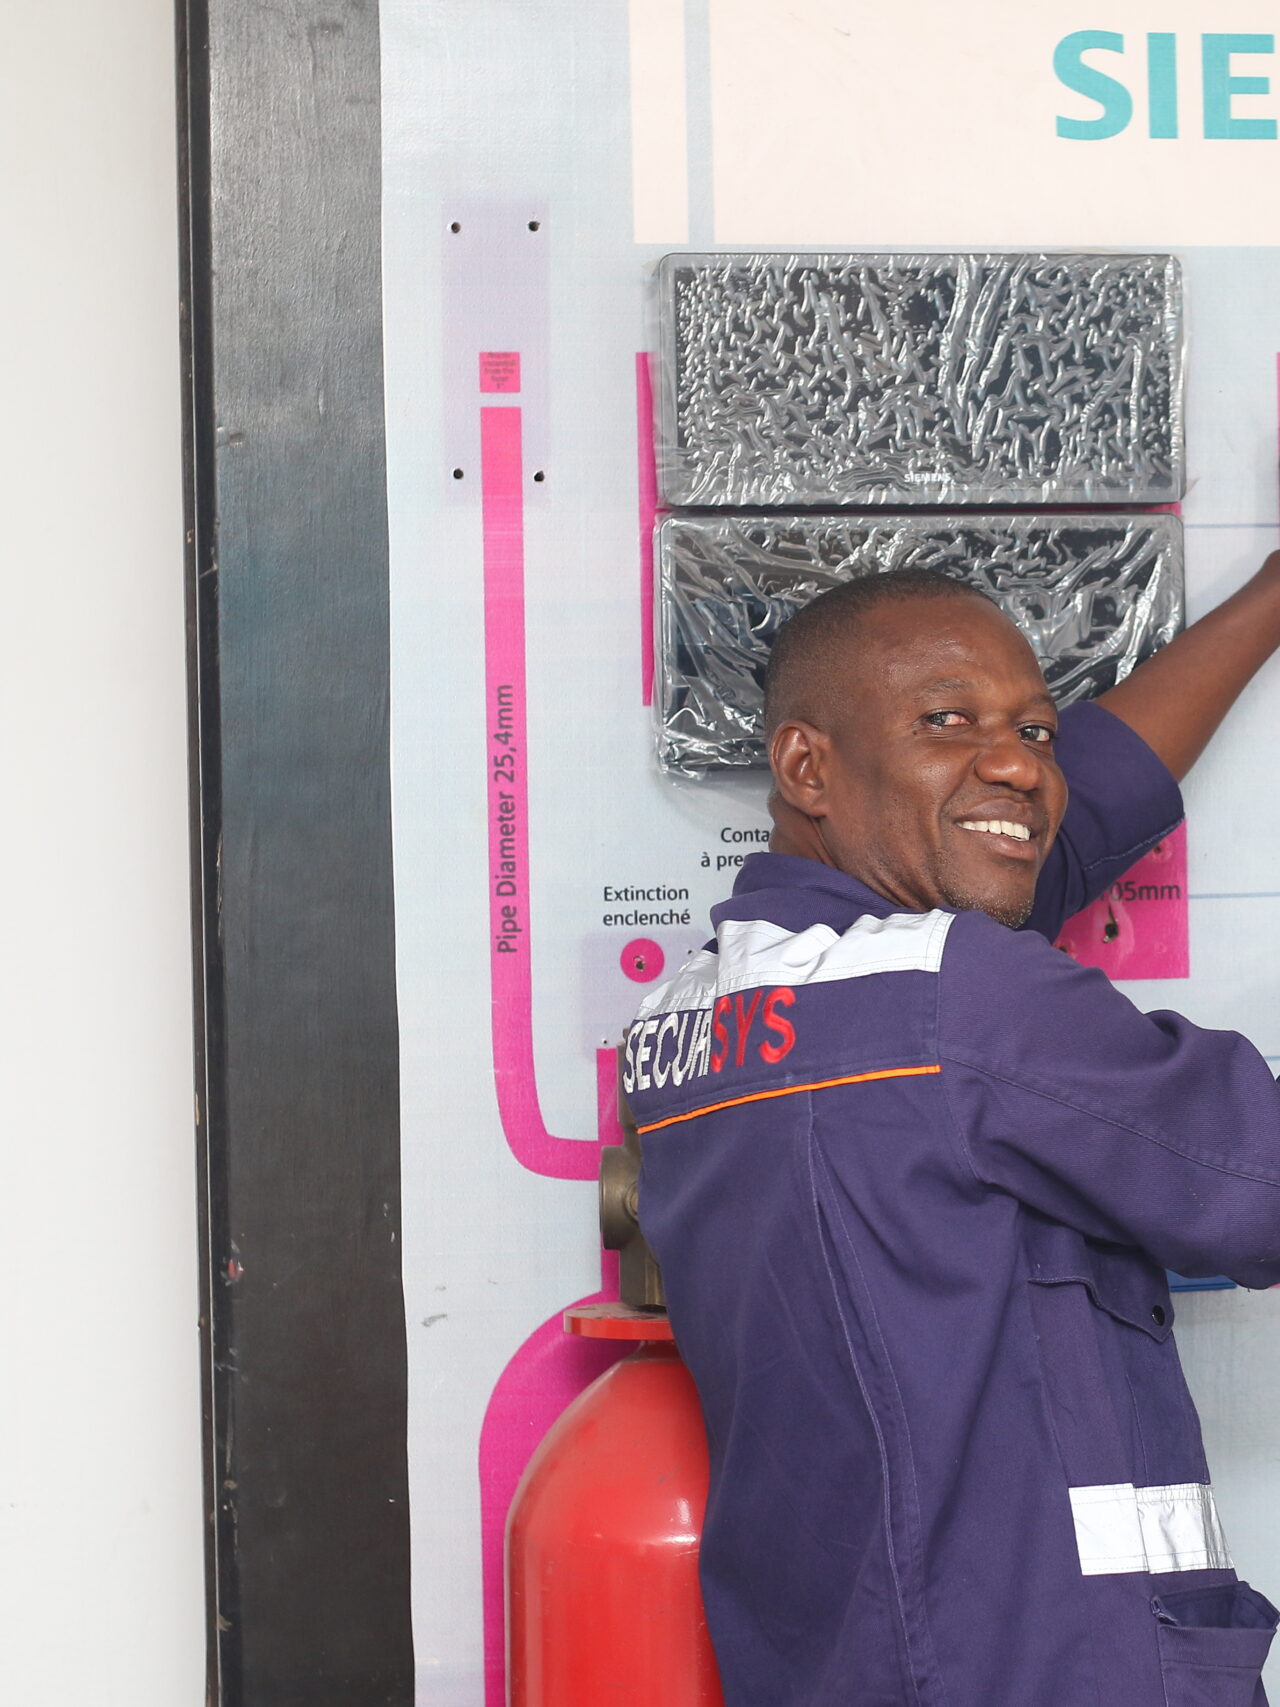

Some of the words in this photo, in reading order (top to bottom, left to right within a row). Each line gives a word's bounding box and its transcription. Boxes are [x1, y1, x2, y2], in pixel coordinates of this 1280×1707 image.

[904, 472, 951, 483] SIEMENS
[494, 684, 517, 782] 25,4mm
[495, 791, 517, 897] Diameter
[701, 851, 711, 868] à
[603, 885, 690, 902] Extinction
[1100, 881, 1181, 901] 05mm
[603, 908, 691, 926] enclenché
[496, 905, 522, 953] Pipe
